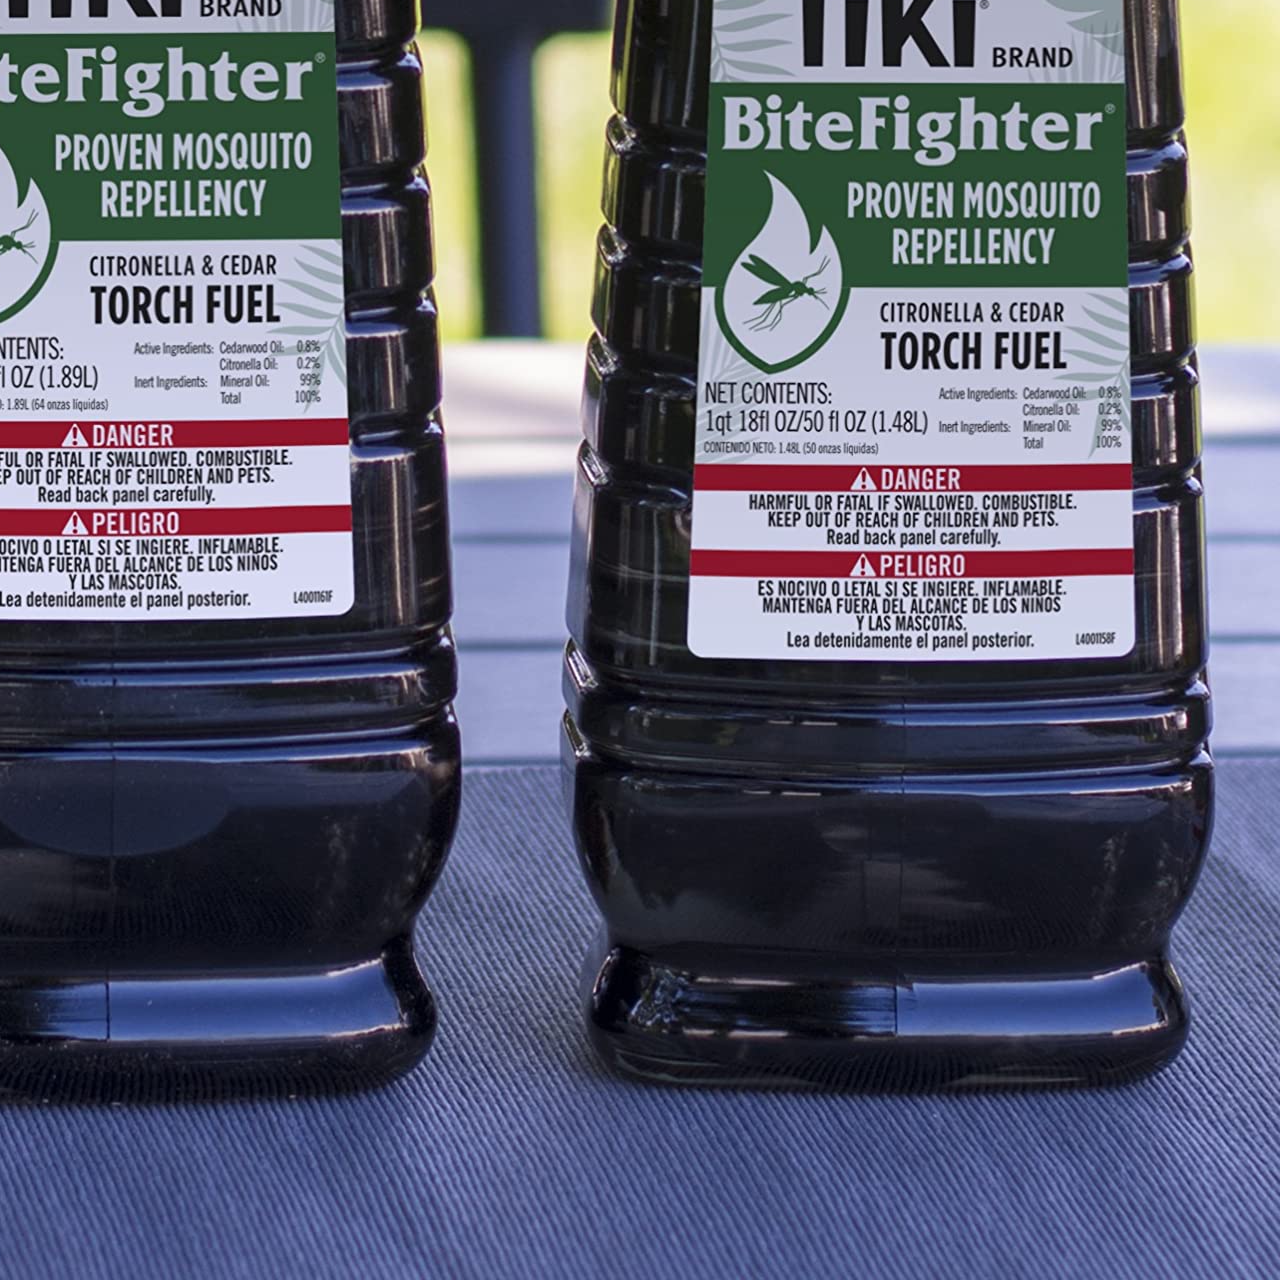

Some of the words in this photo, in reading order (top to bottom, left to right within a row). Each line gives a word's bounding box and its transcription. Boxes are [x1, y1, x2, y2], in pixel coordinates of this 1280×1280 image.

[993, 47, 1073, 67] BRAND
[723, 94, 1102, 166] BiteFighter
[55, 134, 163, 171] PROVEN
[173, 132, 312, 170] MOSQUITO
[101, 180, 266, 217] REPELLENCY
[848, 182, 953, 218] PROVEN
[964, 181, 1100, 218] MOSQUITO
[893, 228, 1055, 264] REPELLENCY
[90, 256, 194, 276] CITRONELLA
[202, 255, 213, 275] &
[221, 255, 276, 275] CEDAR
[90, 285, 193, 324] TORCH
[207, 284, 280, 323] FUEL
[880, 302, 983, 322] CITRONELLA
[991, 302, 1002, 322] &
[1009, 302, 1064, 322] CEDAR
[881, 332, 981, 370] TORCH
[995, 332, 1067, 370] FUEL
[11, 365, 34, 388] OZ
[40, 365, 98, 390] (1.89L)
[705, 382, 737, 404] NET
[741, 382, 831, 404] CONTENTS:
[707, 410, 732, 435] 1qt
[775, 410, 824, 432] OZ/50
[844, 410, 866, 432] OZ
[872, 410, 928, 435] (1.48L)
[93, 424, 173, 446] DANGER
[881, 468, 960, 490] DANGER
[113, 486, 149, 504] panel
[153, 486, 215, 504] carefully.
[93, 512, 179, 534] PELIGRO
[900, 529, 936, 547] panel
[940, 529, 1000, 547] carefully.
[880, 554, 965, 576] PELIGRO
[26, 591, 126, 608] detenidamente
[147, 591, 183, 609] panel
[187, 591, 250, 609] posterior.
[933, 632, 968, 650] panel
[972, 632, 1034, 650] posterior.
